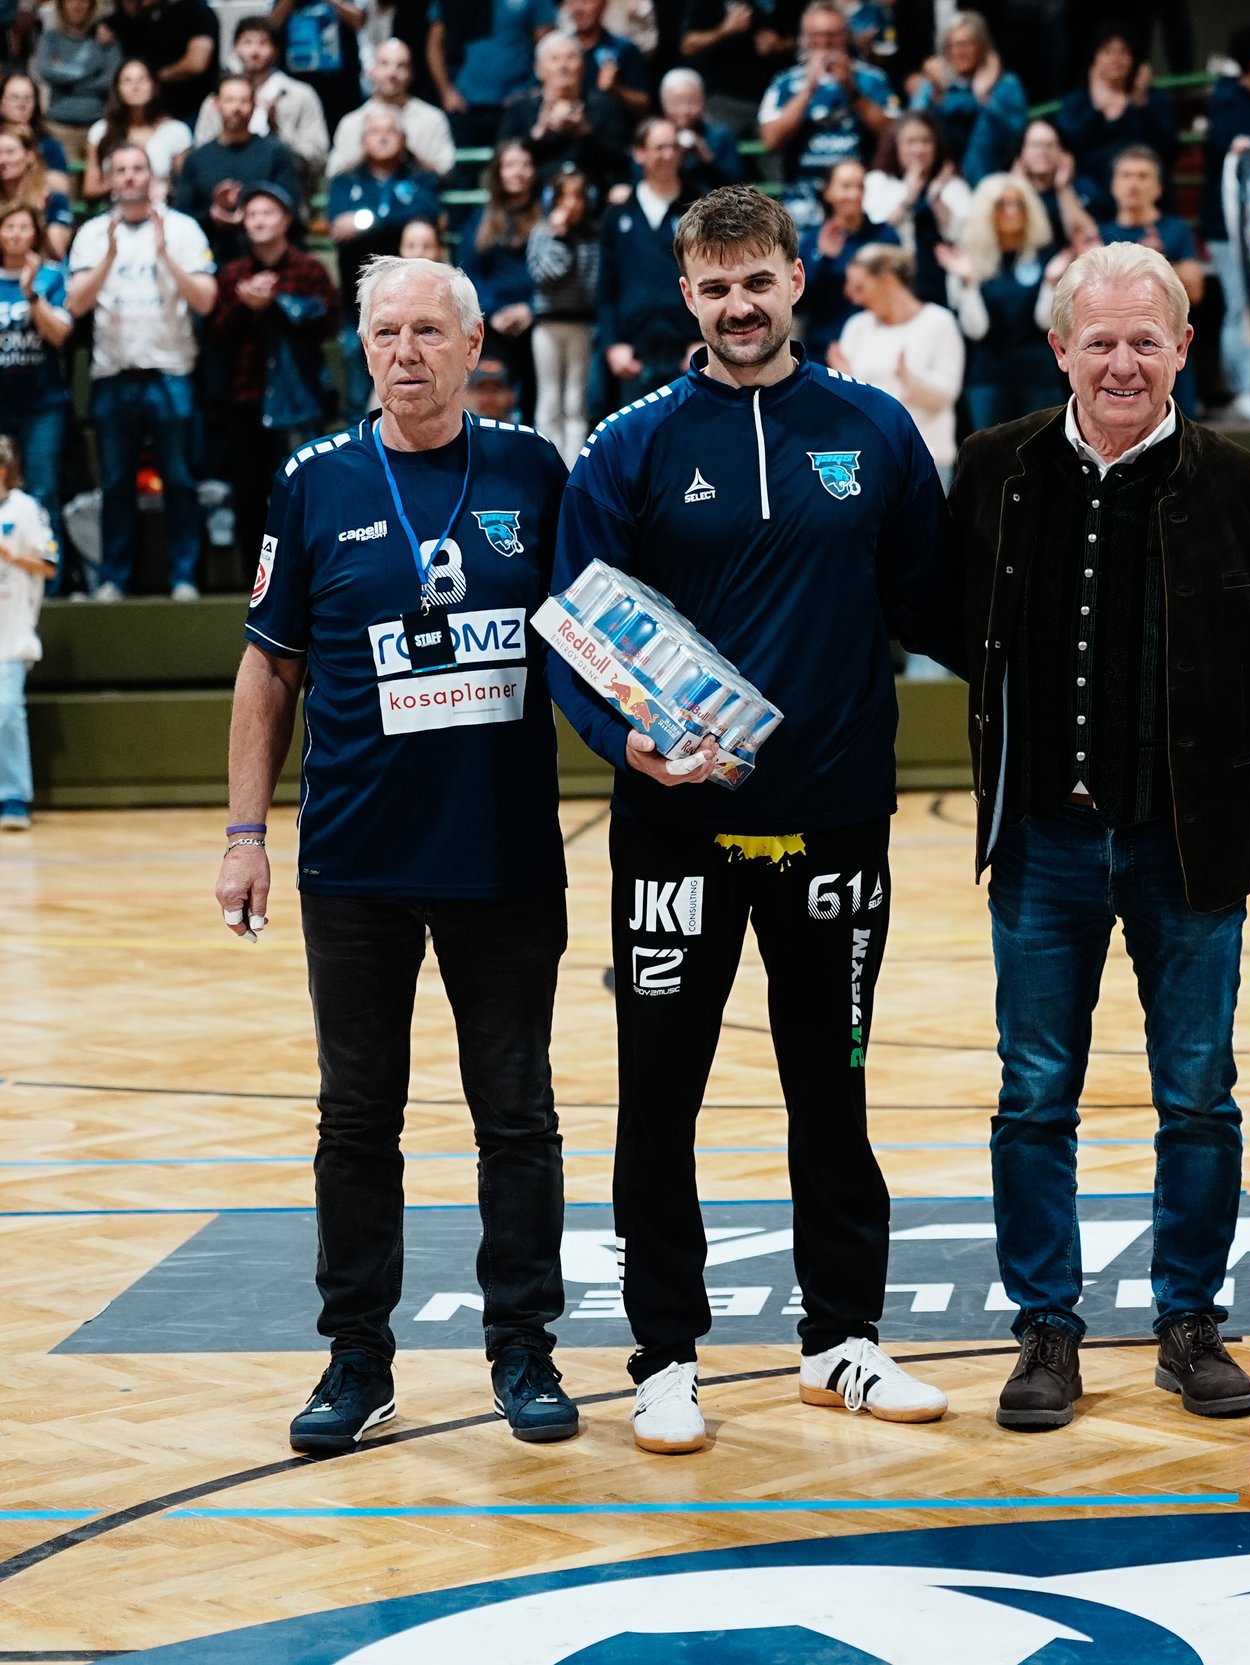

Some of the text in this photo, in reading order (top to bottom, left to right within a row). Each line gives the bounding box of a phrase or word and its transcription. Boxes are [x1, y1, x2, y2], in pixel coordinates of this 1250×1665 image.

[684, 490, 716, 503] SELECT
[338, 520, 388, 542] capelli
[414, 630, 443, 647] STAFF
[550, 633, 599, 683] ENERGY DRINK
[557, 618, 589, 651] Red
[581, 641, 612, 674] Bull
[389, 682, 518, 711] kosaplaner
[629, 878, 677, 933] JK
[688, 879, 698, 933] CONSULTING
[807, 870, 863, 920] 61
